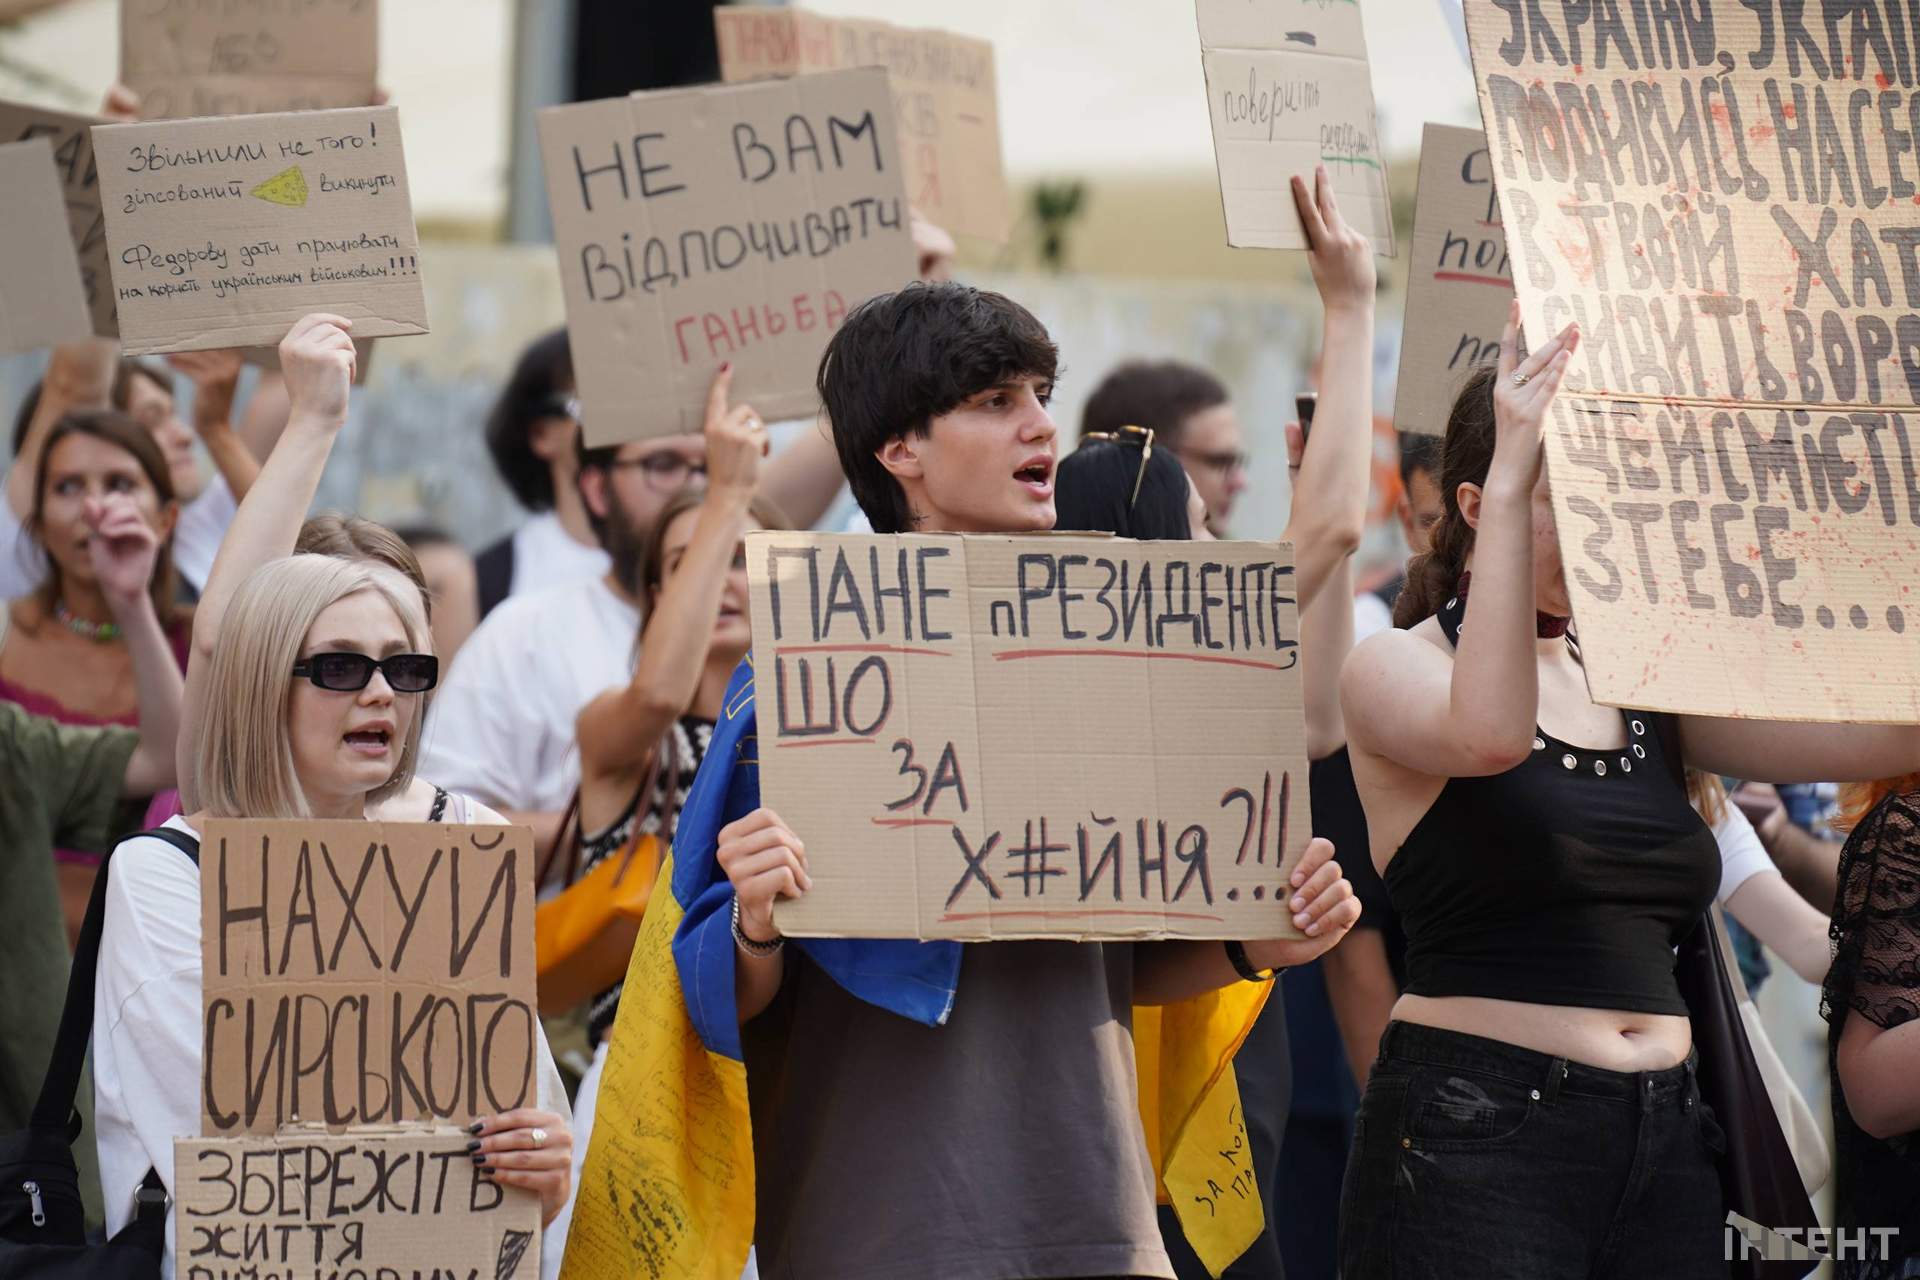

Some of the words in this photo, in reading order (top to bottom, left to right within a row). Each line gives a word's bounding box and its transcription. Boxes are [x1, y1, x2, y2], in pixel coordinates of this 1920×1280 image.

[127, 143, 267, 172] Звільнили
[279, 141, 313, 158] не
[317, 121, 377, 150] того!
[573, 132, 686, 211] НЕ
[732, 110, 884, 183] ВАМ
[123, 180, 243, 213] зіпсований
[319, 172, 396, 195] викинути
[119, 286, 144, 301] на
[149, 279, 201, 298] користь
[211, 271, 303, 298] українським
[121, 240, 228, 276] Федорову
[239, 241, 281, 267] дати
[297, 232, 401, 262] працювати
[673, 291, 849, 364] ГАНЬБА
[768, 545, 953, 642] ПАНЕ
[776, 655, 894, 737] ШО
[884, 740, 970, 815] ЗА
[219, 831, 517, 978] НАХУЙ
[205, 991, 533, 1137] СИРСЬКОГО
[186, 1144, 504, 1221] ЗБЕРЕЖІТЬ
[190, 1221, 364, 1266] ЖИТТЯ
